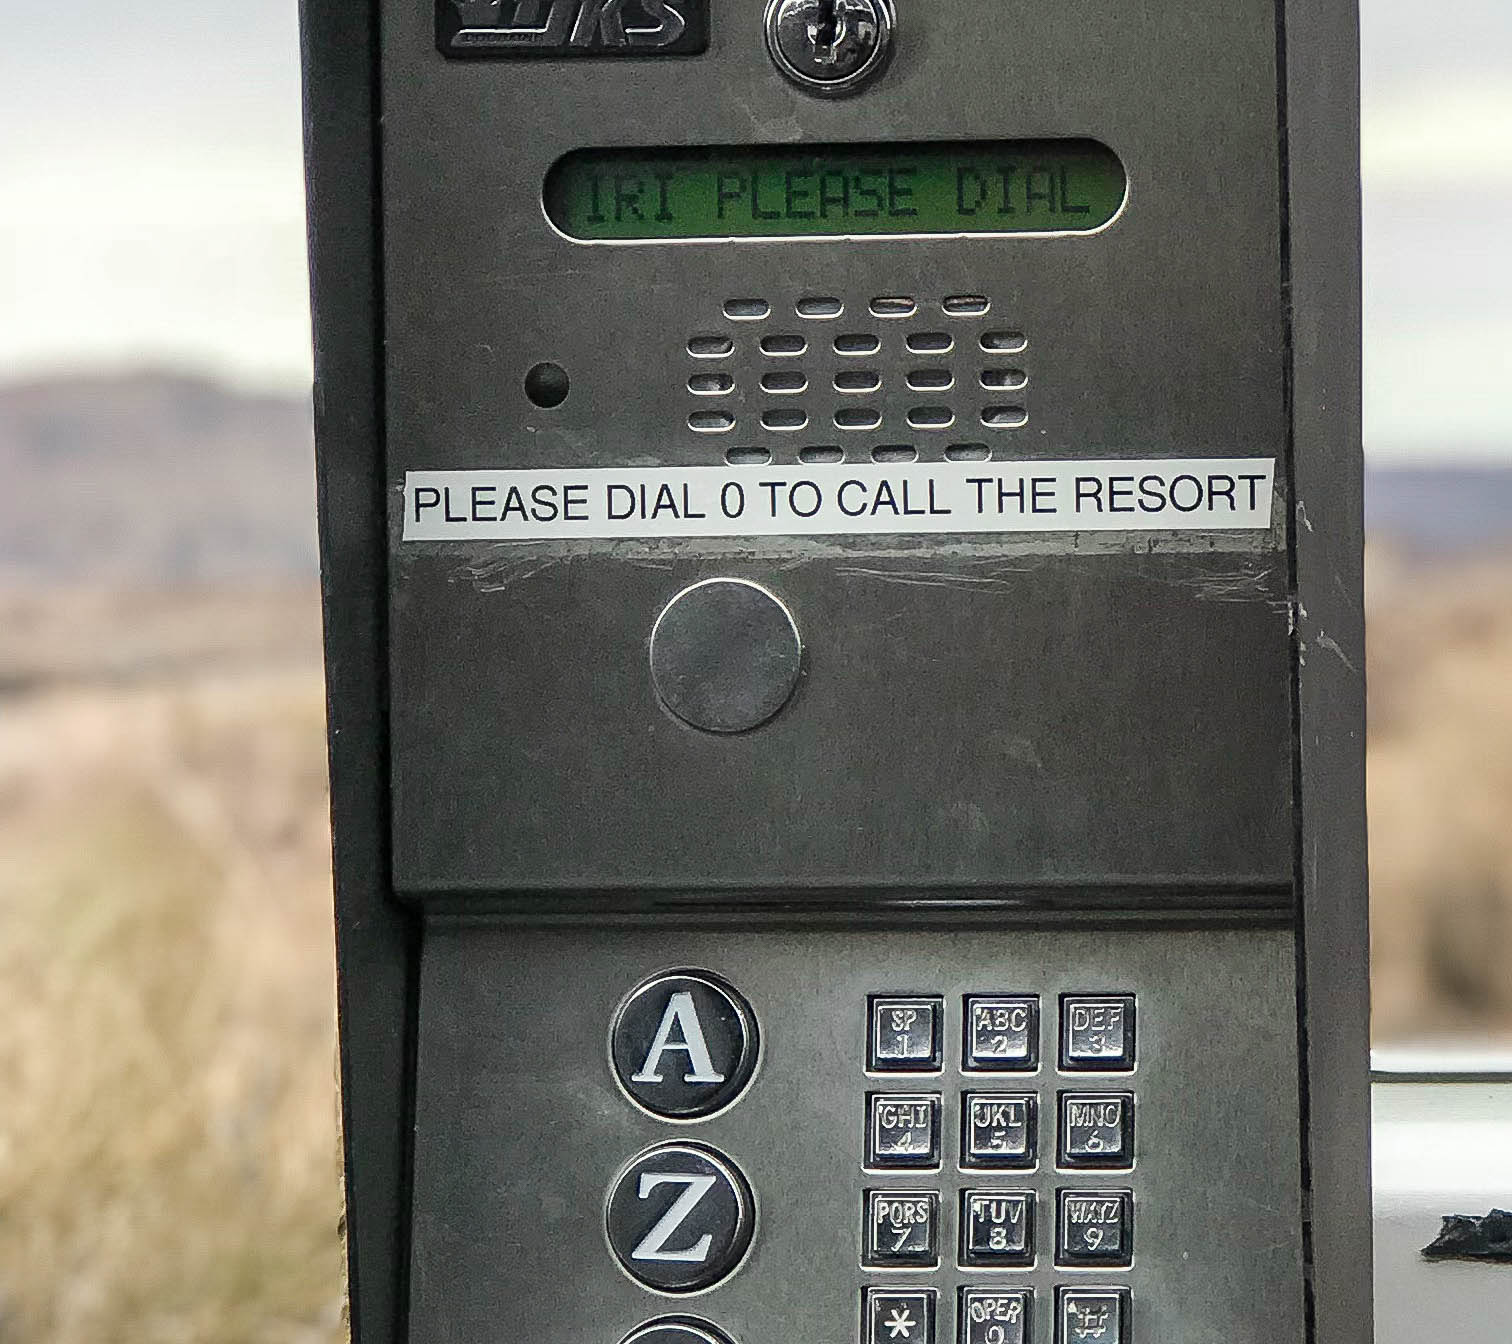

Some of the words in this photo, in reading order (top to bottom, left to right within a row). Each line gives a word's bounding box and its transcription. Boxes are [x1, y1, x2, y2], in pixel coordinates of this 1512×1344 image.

[716, 166, 918, 220] PLEASE
[957, 164, 1091, 216] DIAL
[414, 484, 590, 523] PLEASE
[607, 482, 706, 520] DIAL
[758, 480, 823, 518] TO
[836, 478, 952, 516] CALL
[966, 476, 1058, 514] THE
[1075, 474, 1268, 513] RESORT
[976, 1008, 1028, 1032] ABC
[1073, 1008, 1122, 1032] DEF
[631, 990, 726, 1083] A
[896, 1035, 910, 1056] 1
[990, 1035, 1009, 1055] 2
[1088, 1034, 1106, 1055] 3
[880, 1105, 928, 1129] GHI
[974, 1105, 1023, 1128] JKL
[1070, 1105, 1121, 1128] MNO
[894, 1131, 913, 1152] 4
[990, 1131, 1007, 1150] 5
[1085, 1130, 1104, 1153] 6
[631, 1172, 717, 1263] Z
[877, 1201, 929, 1228] PQRS
[974, 1200, 1025, 1224] TUV
[890, 1227, 912, 1252] 7
[990, 1226, 1008, 1251] 8
[1083, 1227, 1105, 1251] 9
[970, 1299, 1023, 1324] OPER
